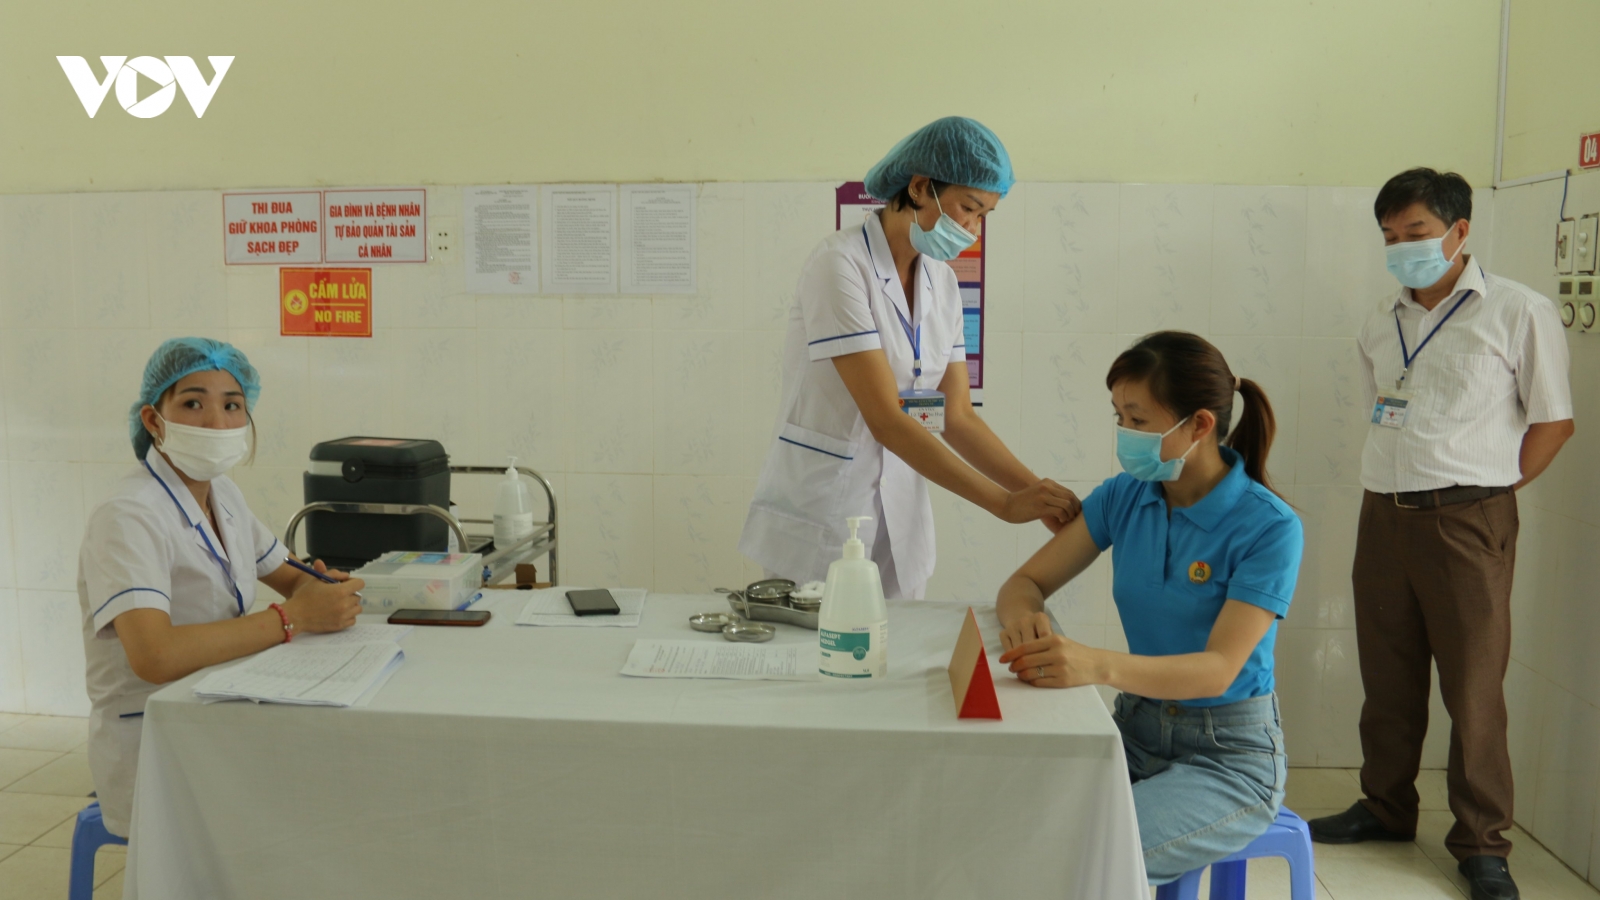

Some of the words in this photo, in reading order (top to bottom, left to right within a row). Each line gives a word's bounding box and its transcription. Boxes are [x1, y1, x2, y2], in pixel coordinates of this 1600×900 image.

[1584, 138, 1596, 163] 04
[252, 202, 268, 214] THI
[271, 202, 293, 214] ĐUA
[329, 205, 343, 218] GIA
[344, 202, 362, 217] ĐÌNH
[364, 203, 375, 217] VÀ
[376, 202, 397, 220] BỆNH
[398, 202, 420, 216] NHÂN
[228, 219, 247, 234] GIỮ
[249, 222, 278, 234] KHOA
[281, 218, 317, 233] PHÒNG
[334, 225, 345, 241] TỰ
[346, 221, 361, 238] BẢO
[363, 220, 384, 238] QUẢN
[386, 223, 399, 237] TÀI
[400, 220, 416, 237] SẢN
[247, 241, 276, 256] SẠCH
[279, 241, 299, 256] ĐẸP
[358, 244, 369, 258] CÁ
[370, 244, 392, 257] NHÂN
[309, 278, 338, 299] CẤM
[342, 277, 367, 299] LỬA
[315, 311, 332, 323] NO
[336, 311, 361, 323] FIRE
